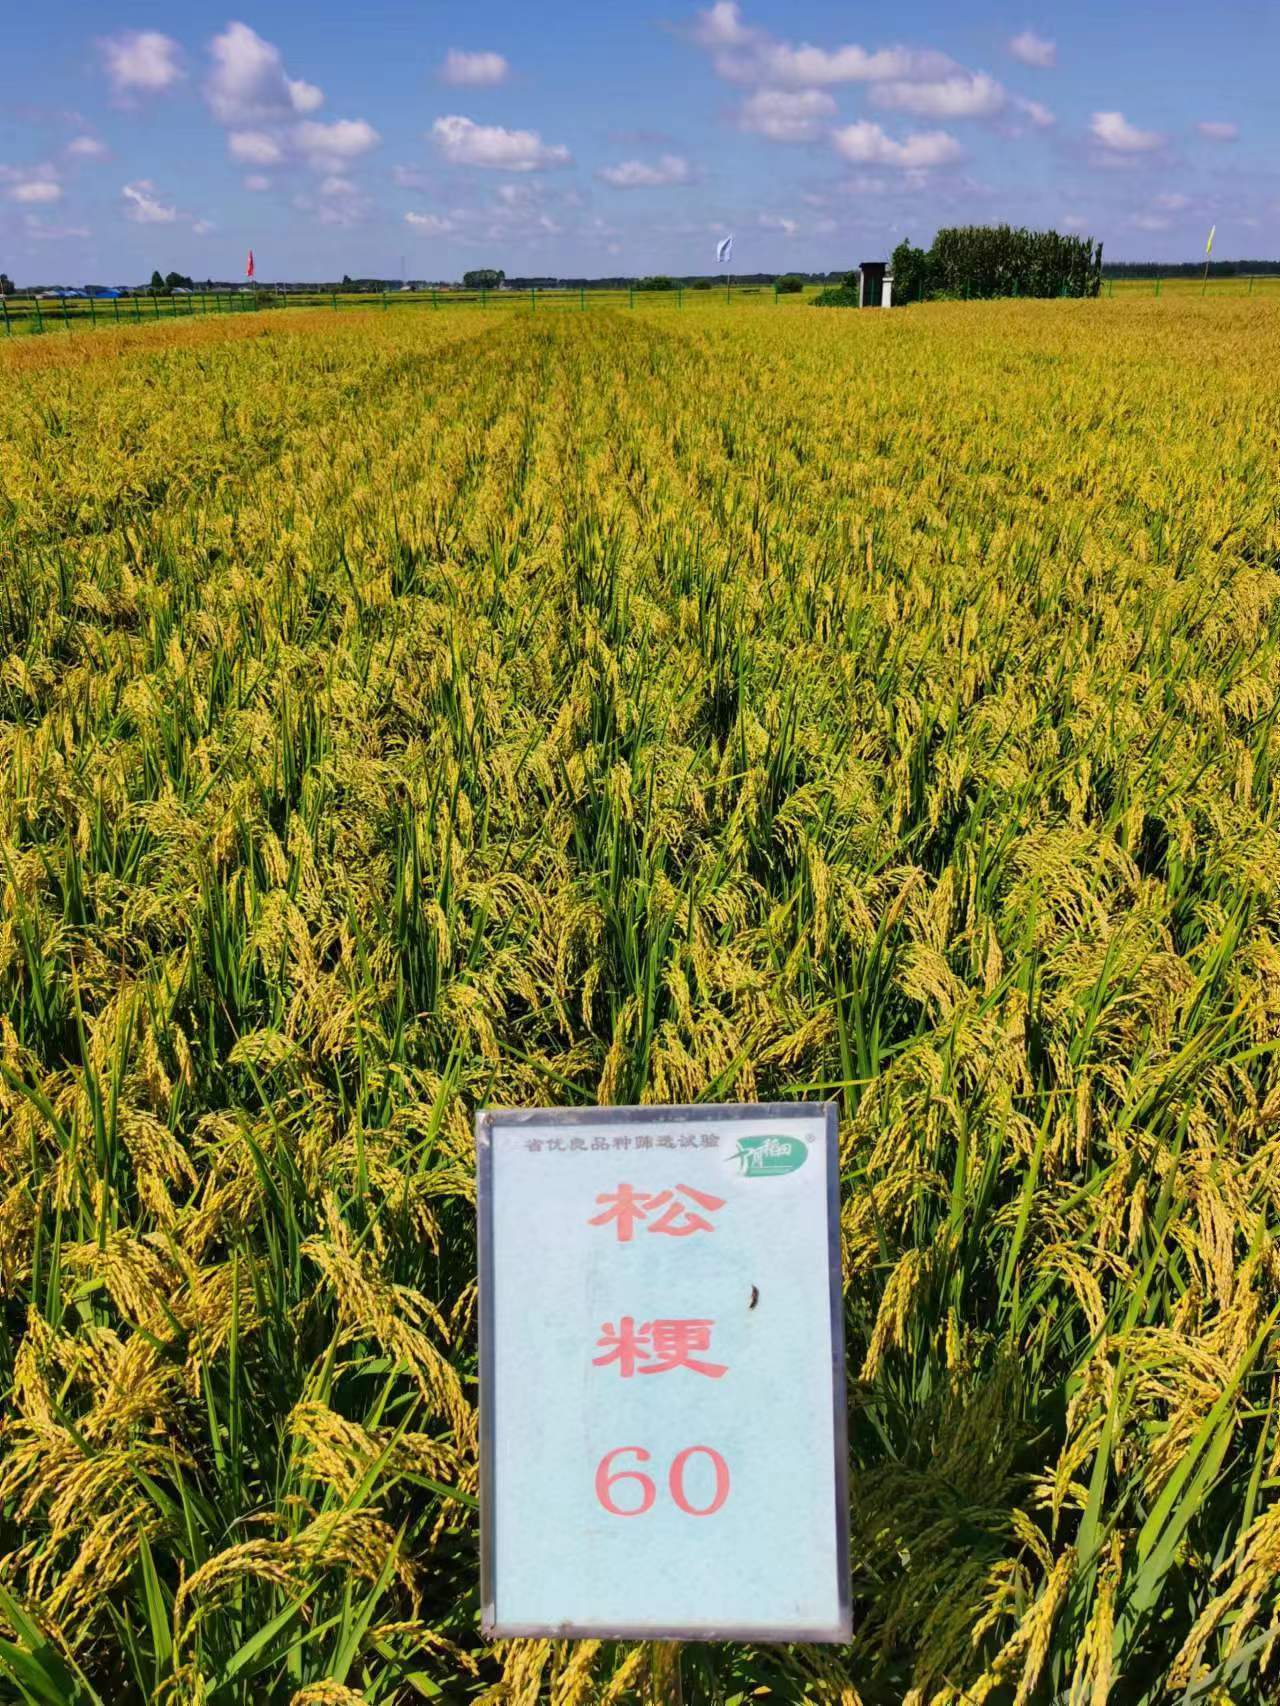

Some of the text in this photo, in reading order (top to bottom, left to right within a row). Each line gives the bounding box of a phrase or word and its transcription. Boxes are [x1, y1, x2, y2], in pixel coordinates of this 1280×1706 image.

[589, 1183, 725, 1242] 松
[592, 1316, 727, 1379] 粳
[595, 1446, 730, 1517] 60
